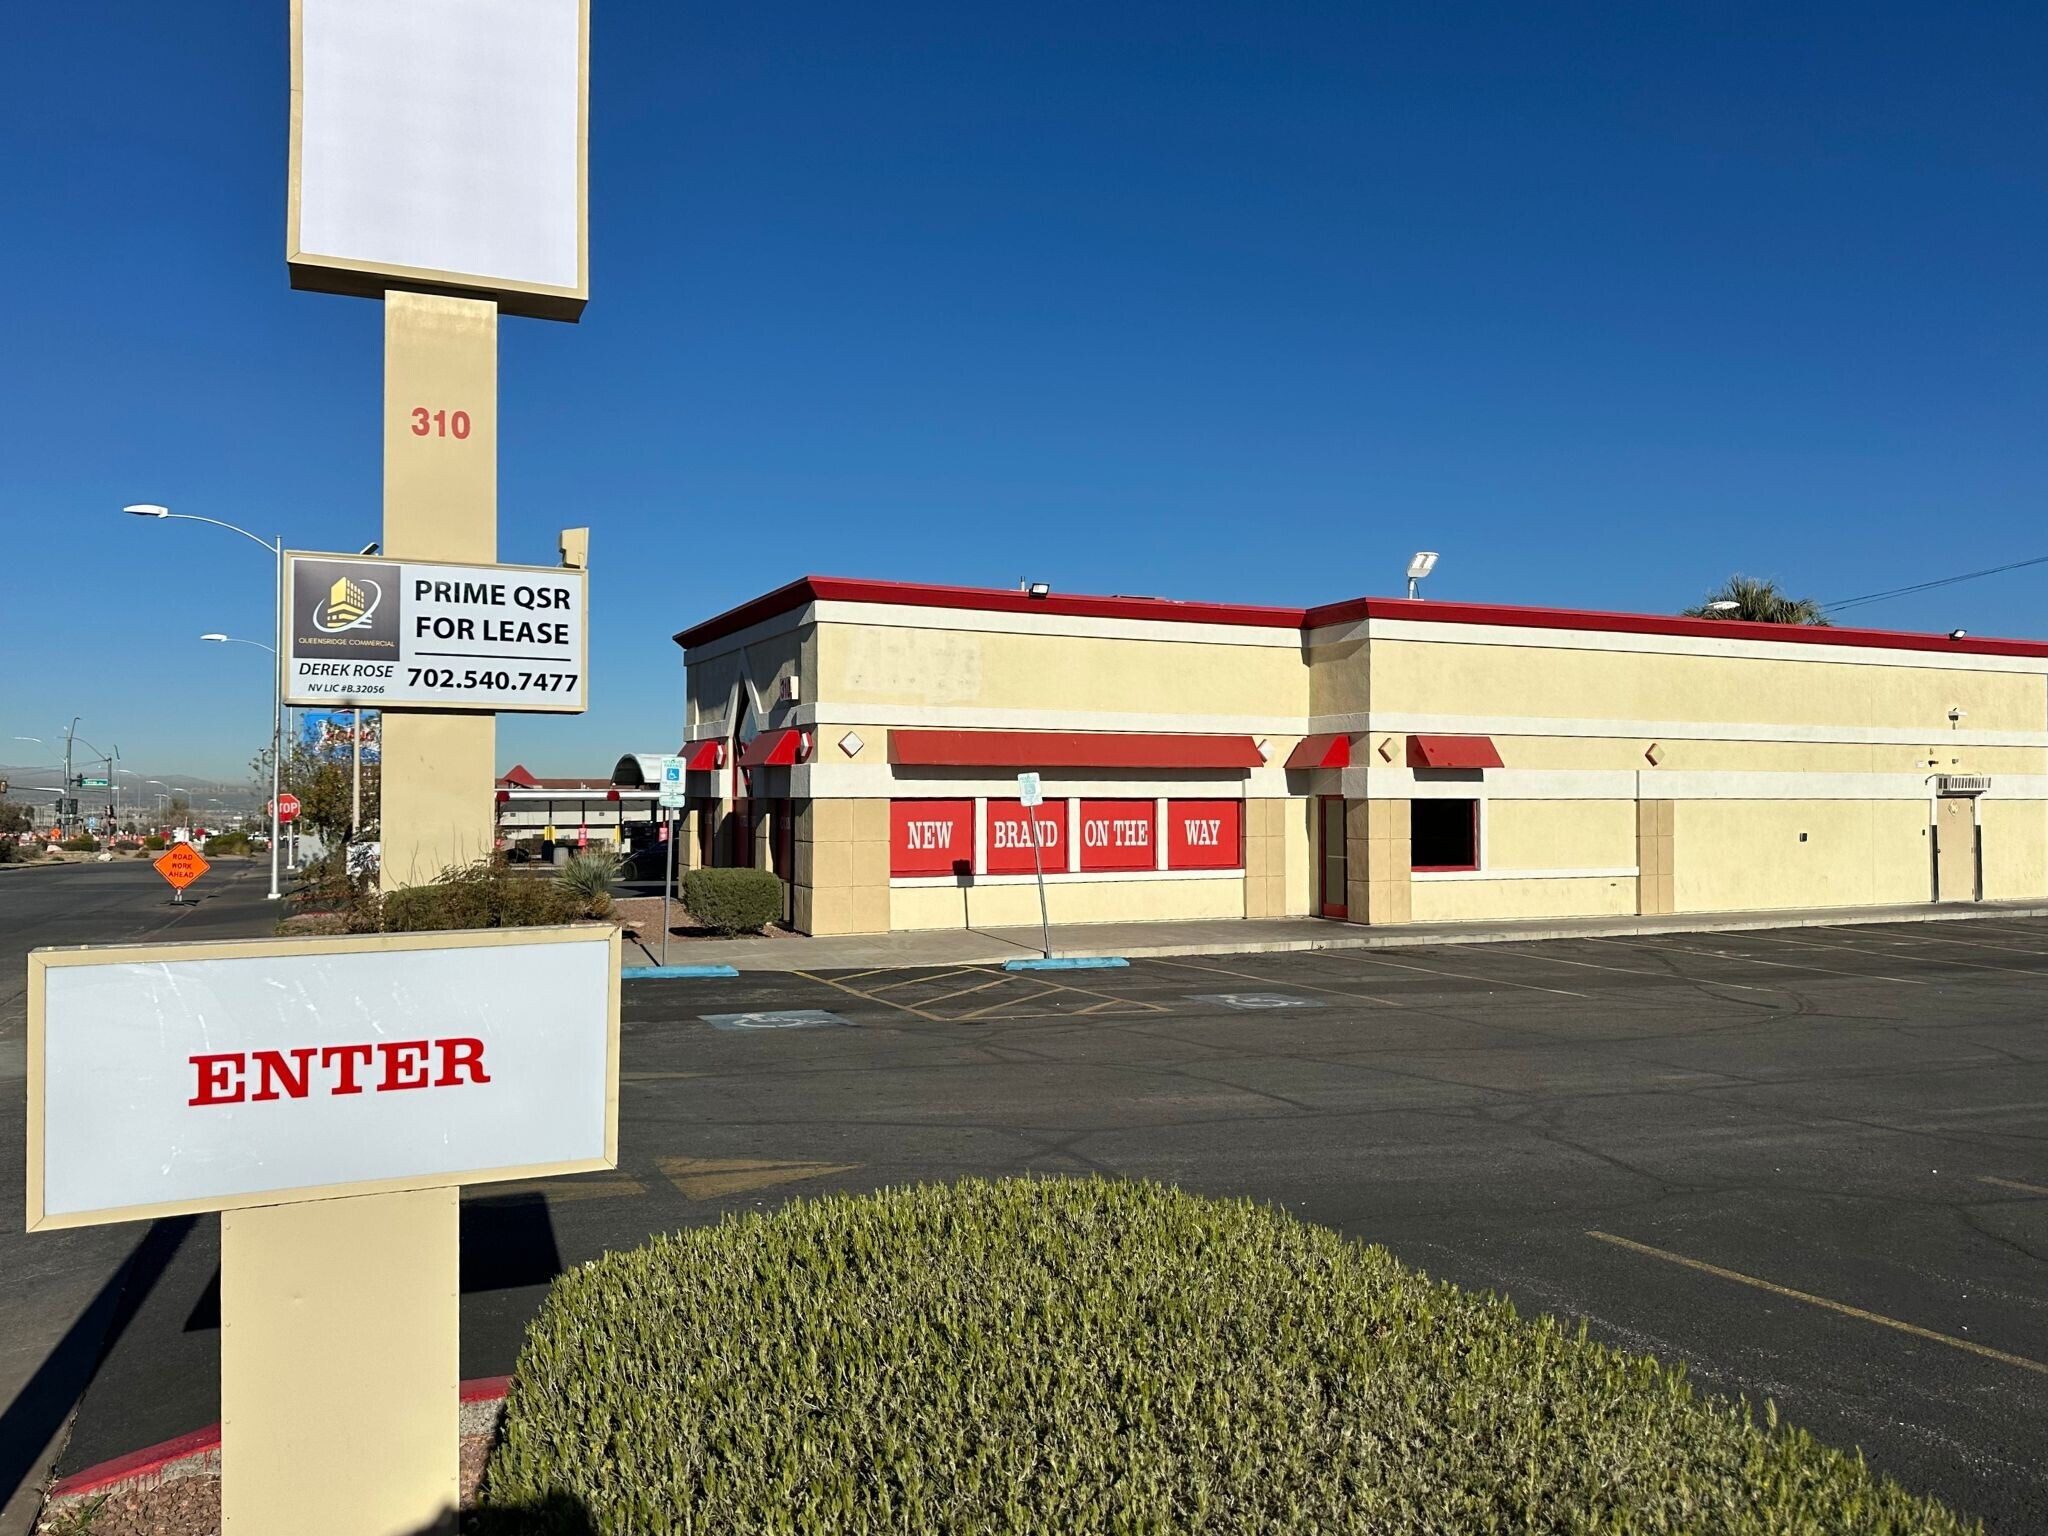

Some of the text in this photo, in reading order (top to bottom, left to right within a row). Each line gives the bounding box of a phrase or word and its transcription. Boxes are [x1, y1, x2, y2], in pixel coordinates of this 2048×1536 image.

[411, 407, 471, 439] 310
[415, 580, 571, 611] PRIME QSR
[415, 616, 569, 645] FOR LEASE
[298, 637, 396, 648] QUEENSRIDGE COMMERCIAL
[299, 662, 394, 678] DEREK ROSE
[407, 668, 579, 692] 702.540.7477
[308, 683, 385, 694] NV LIC #B.32056
[270, 802, 298, 814] TOP
[907, 819, 1221, 849] NEW BRAND ON THE WAY
[171, 862, 192, 870] WORK
[172, 853, 193, 861] ROAD
[188, 1037, 491, 1107] ENTER
